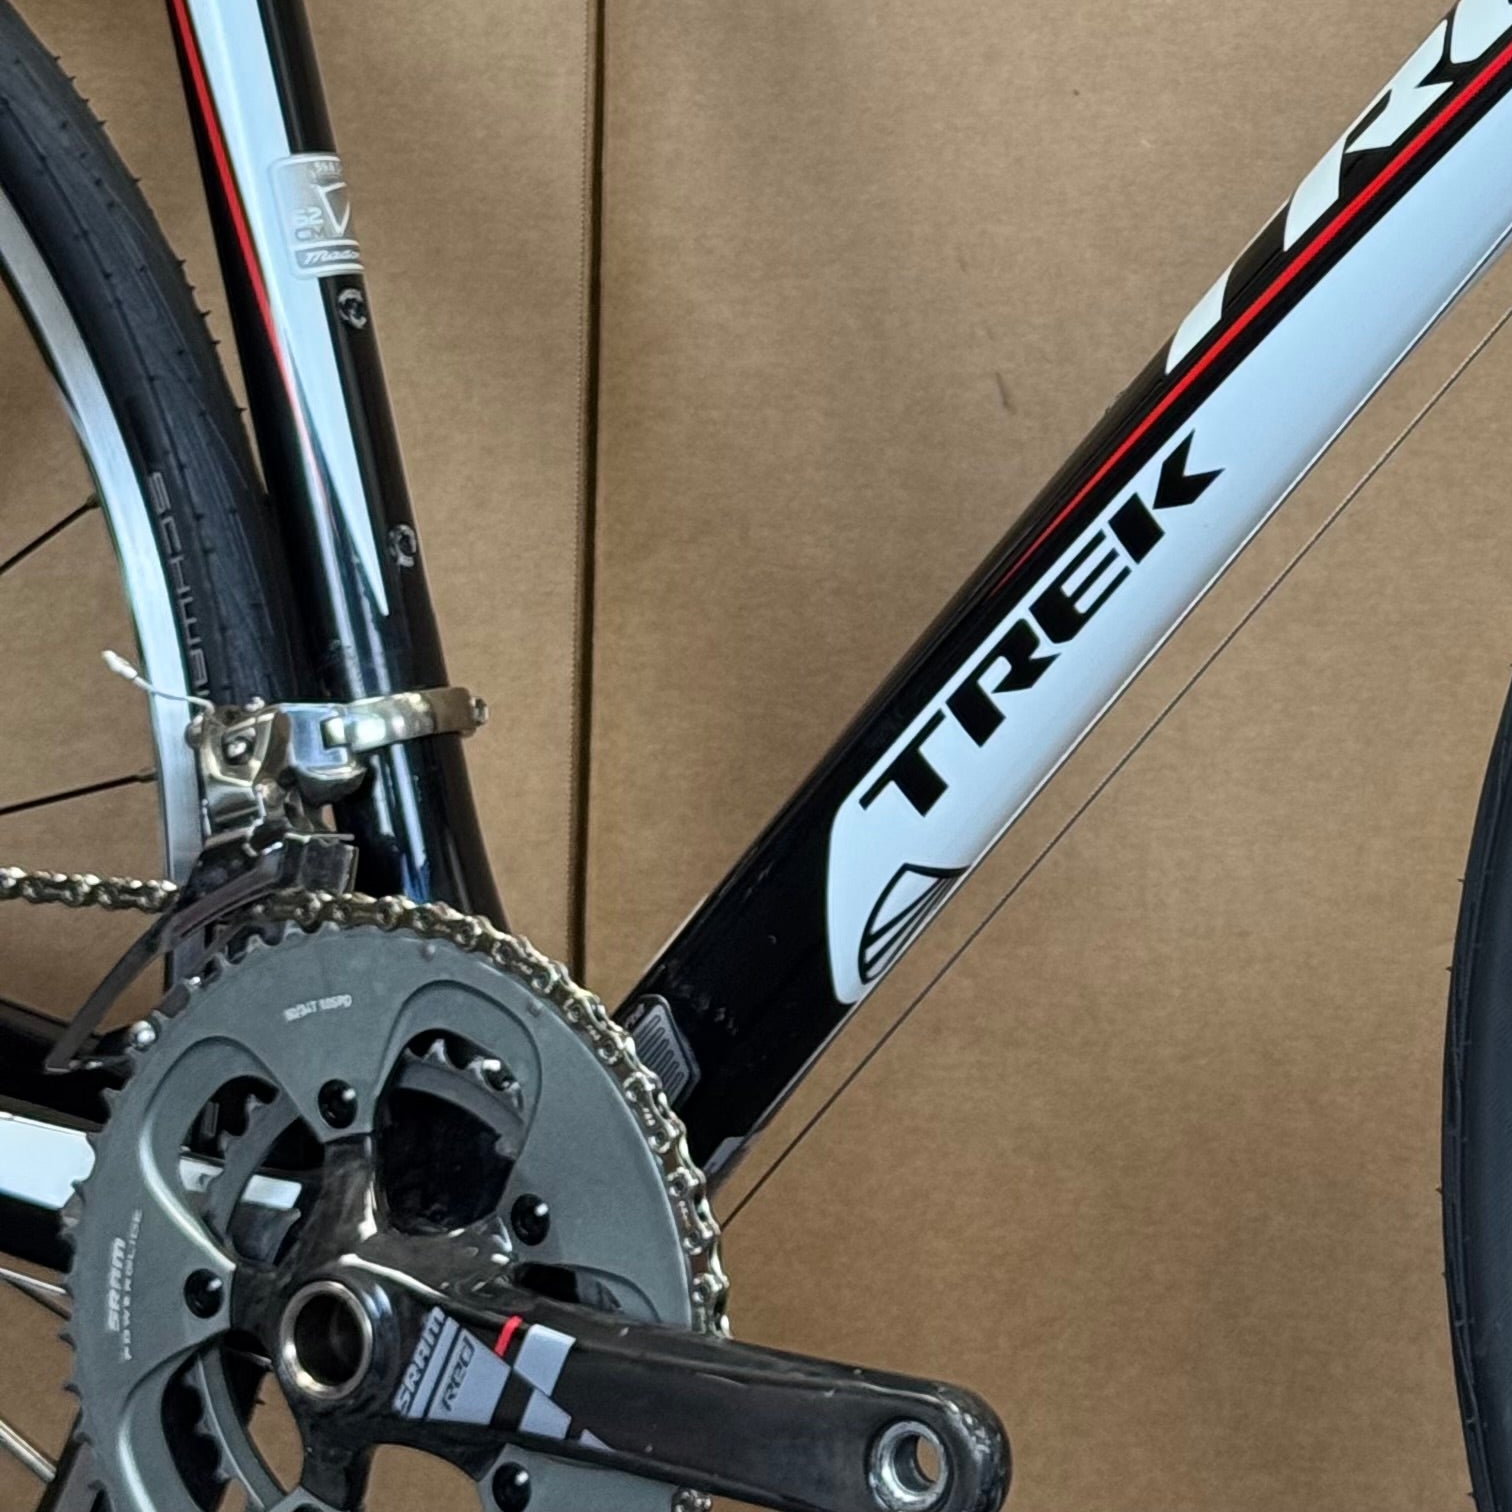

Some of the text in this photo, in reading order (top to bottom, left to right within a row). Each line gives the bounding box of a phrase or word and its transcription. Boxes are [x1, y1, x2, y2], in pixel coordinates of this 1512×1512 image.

[150, 471, 211, 698] SCHWA
[858, 428, 1226, 817] TREK
[107, 1237, 127, 1332] SRAM
[395, 1312, 446, 1417] SRAM
